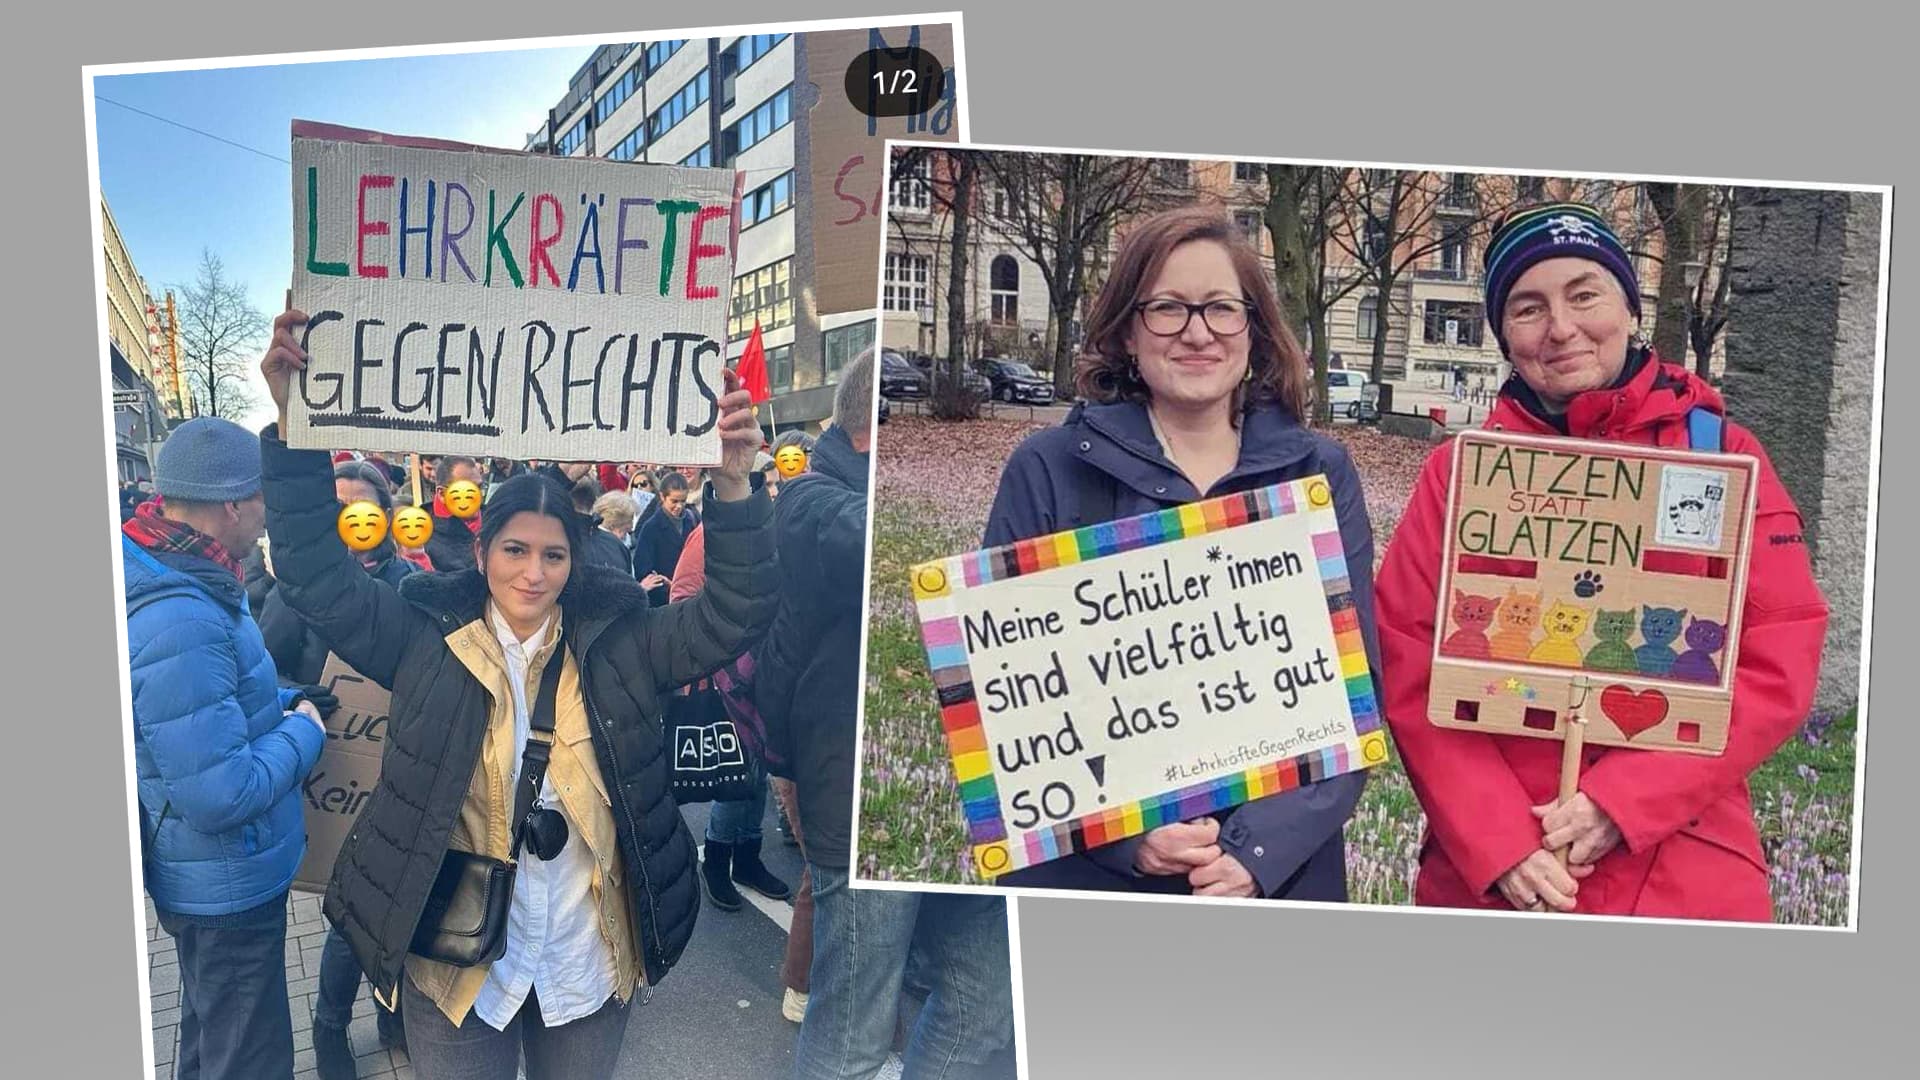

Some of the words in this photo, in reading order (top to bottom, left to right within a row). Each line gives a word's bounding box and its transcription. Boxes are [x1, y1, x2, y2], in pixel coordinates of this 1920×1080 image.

[307, 167, 728, 300] LEHRKRÄFTE
[299, 310, 506, 424] GEGEN
[520, 320, 721, 436] RECHTS
[1466, 442, 1645, 501] TATZEN
[1507, 491, 1592, 514] STATT
[1458, 509, 1643, 567] GLATZEN
[962, 608, 1065, 655] Meine
[984, 652, 1069, 713] sind
[1088, 603, 1293, 686] vielfältig
[998, 712, 1083, 774] und
[1106, 686, 1181, 742] das
[1197, 670, 1258, 716] ist
[1274, 647, 1336, 709] gut
